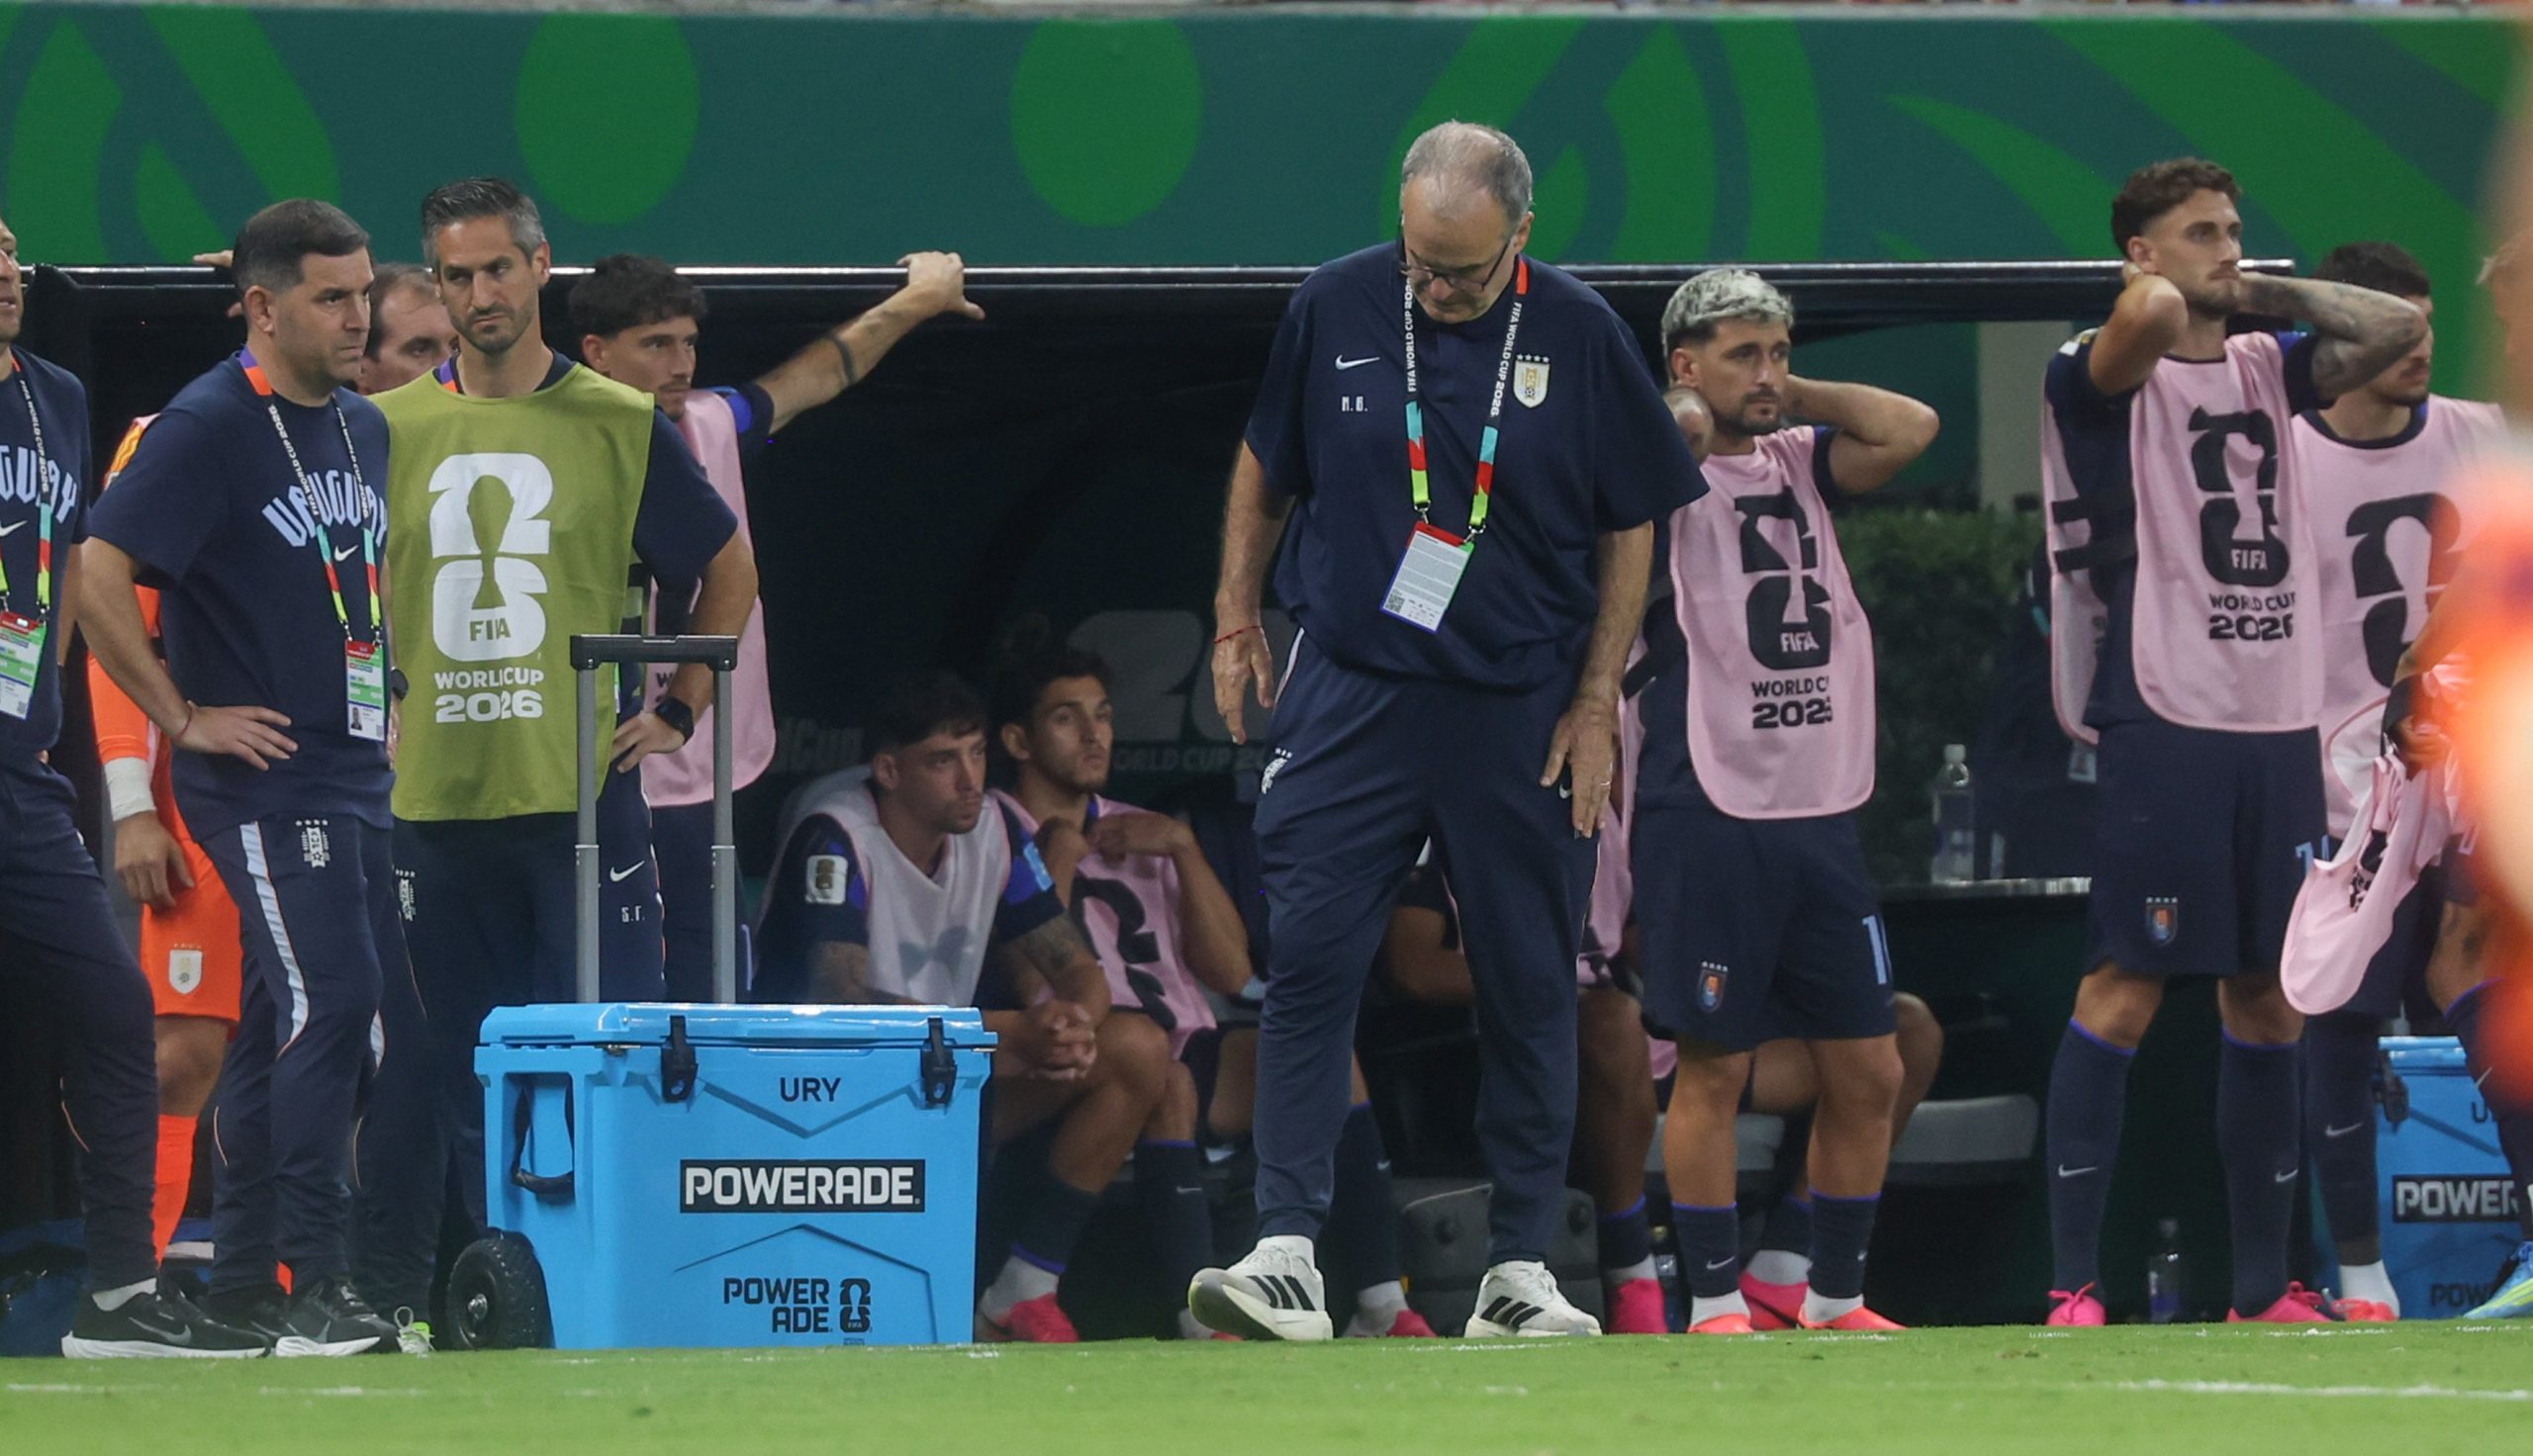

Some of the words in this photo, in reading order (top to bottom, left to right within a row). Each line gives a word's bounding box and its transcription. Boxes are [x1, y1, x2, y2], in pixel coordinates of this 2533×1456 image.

[1404, 277, 1413, 310] 202
[1404, 312, 1414, 331] CUP
[1510, 302, 1523, 323] FIFA
[1405, 332, 1416, 370] WORLD
[1502, 324, 1518, 360] WORLD
[1407, 370, 1417, 393] FIFA
[1497, 360, 1509, 381] CUP
[1490, 380, 1505, 417] 2026
[2230, 549, 2269, 571] FIFA
[2208, 593, 2263, 612] WORD
[469, 617, 512, 642] FIA
[1780, 631, 1820, 653] FIFA
[433, 668, 504, 690] WORL
[503, 666, 544, 686] CUP
[1751, 678, 1815, 698] WORLD
[434, 688, 544, 724] 2026
[780, 1077, 841, 1103] URY
[685, 1166, 914, 1206] POWERADE
[723, 1277, 829, 1305] POWER
